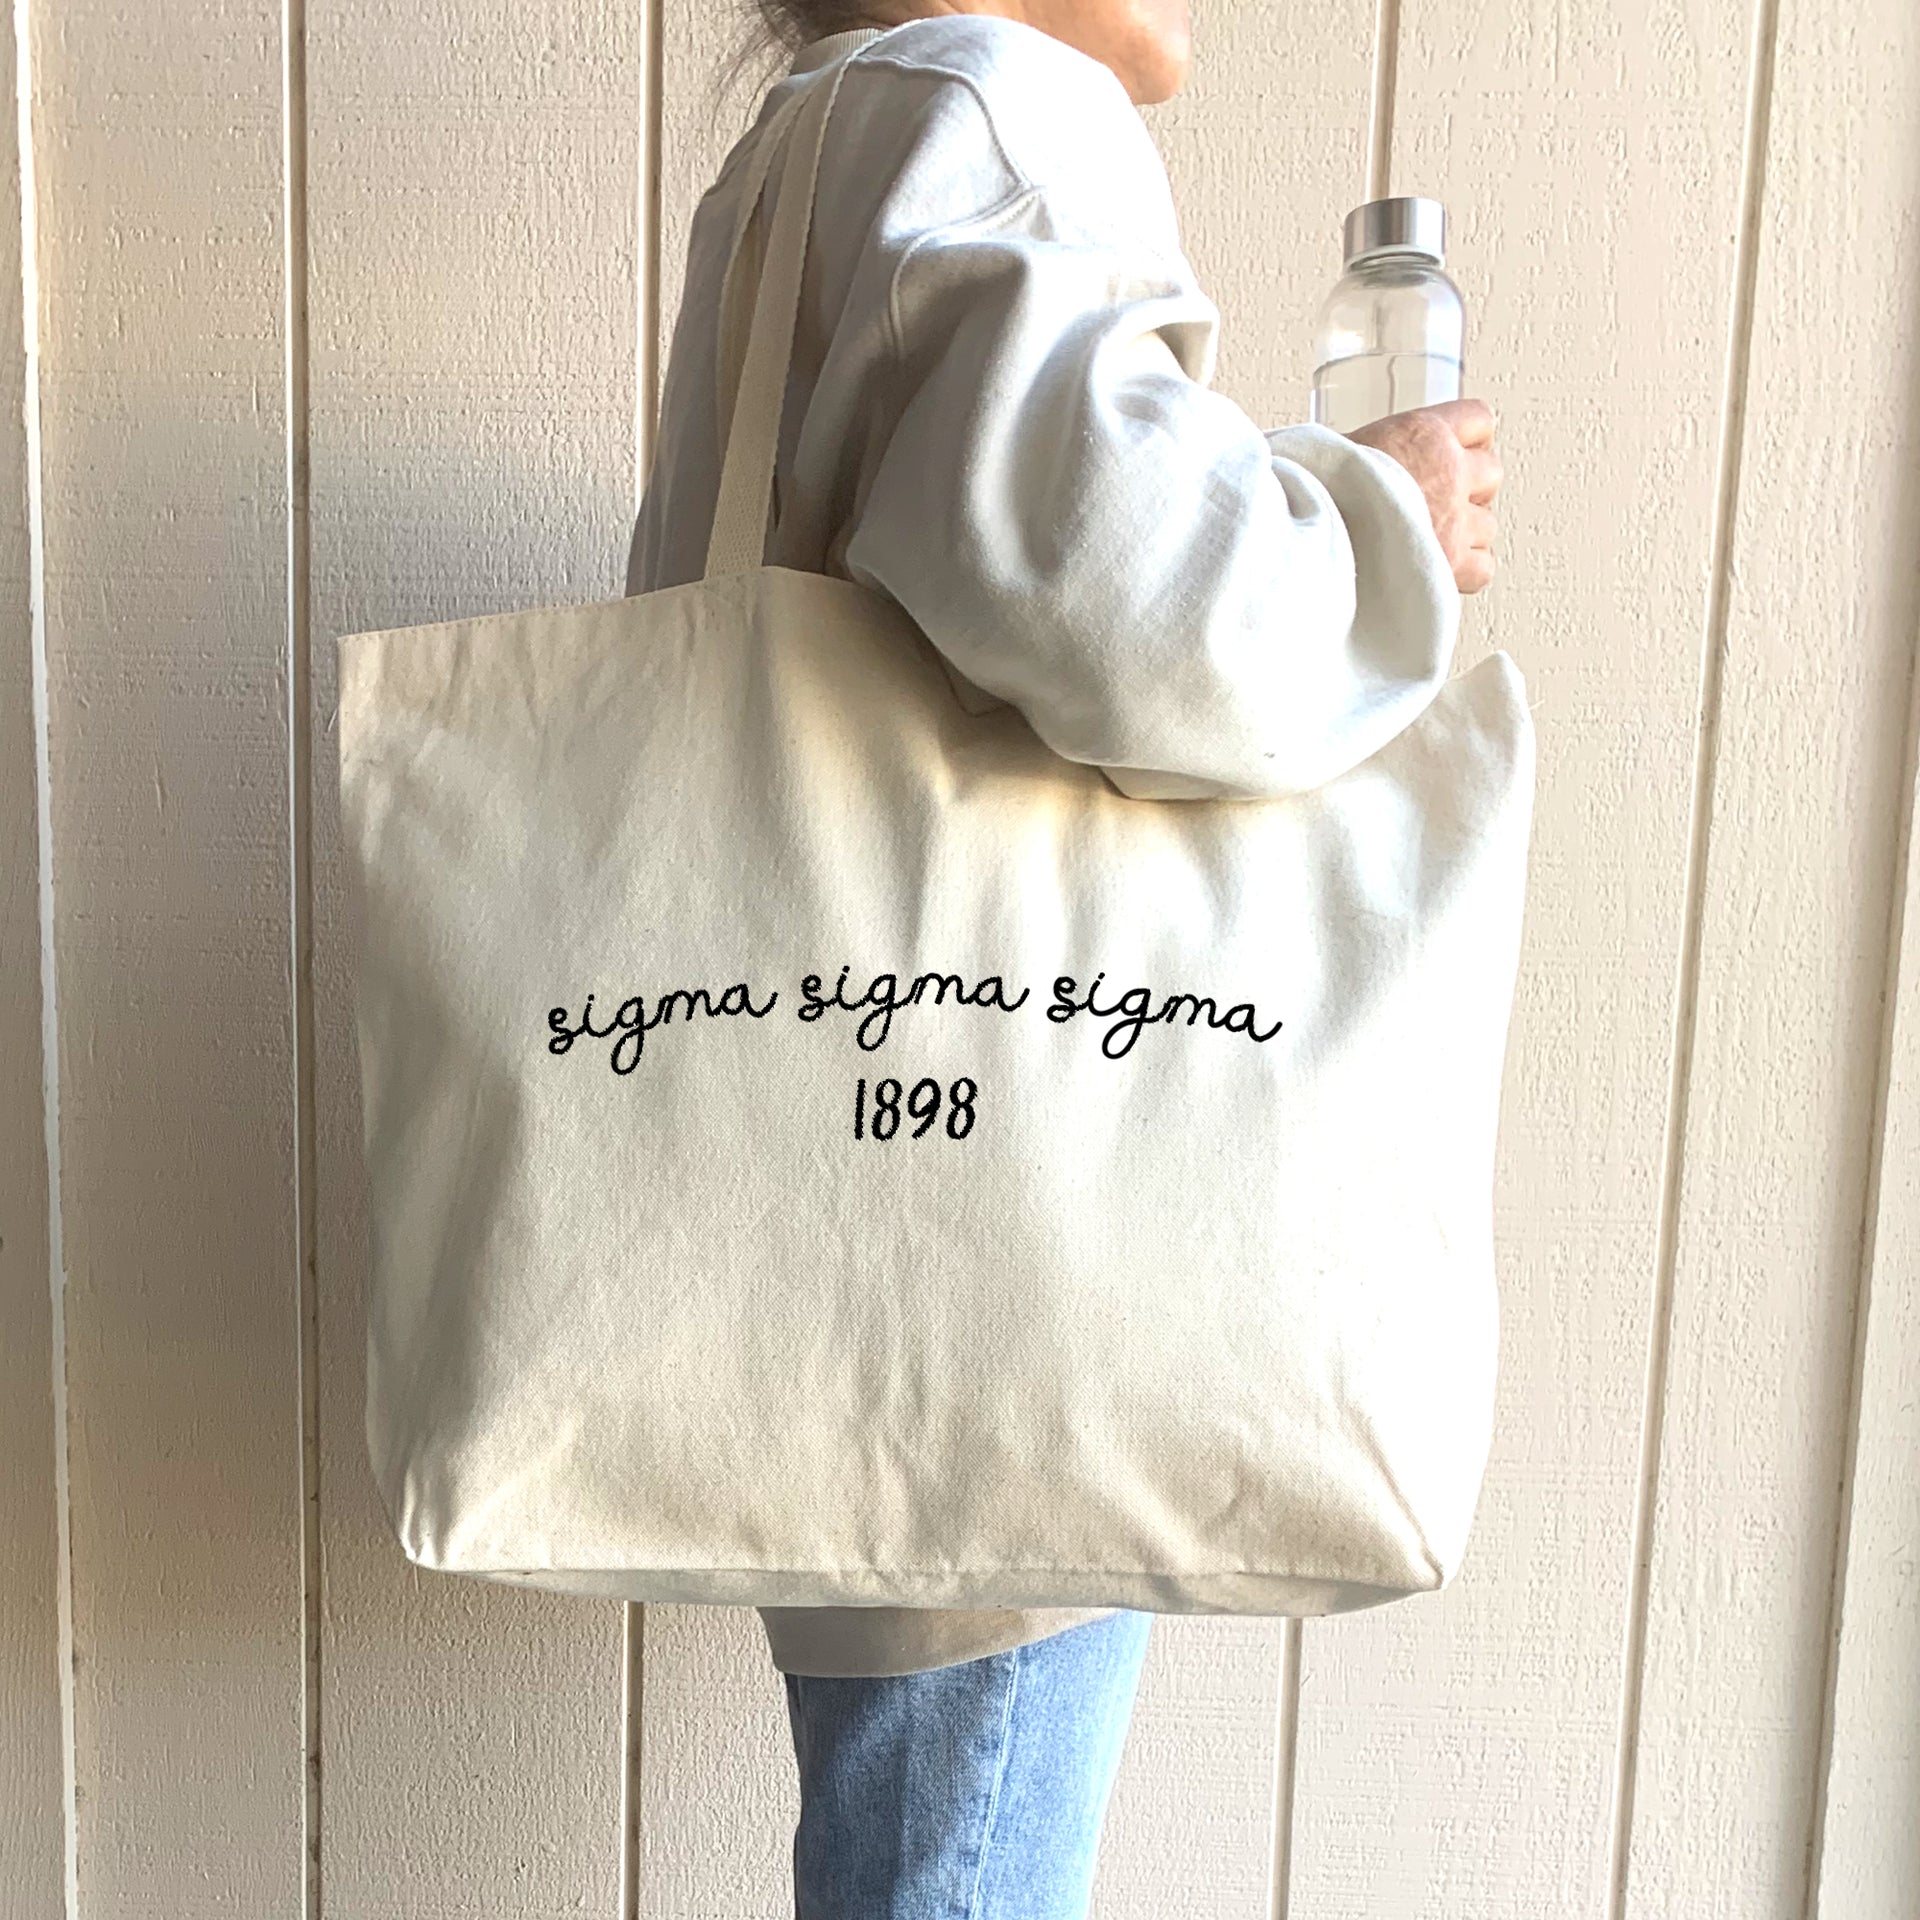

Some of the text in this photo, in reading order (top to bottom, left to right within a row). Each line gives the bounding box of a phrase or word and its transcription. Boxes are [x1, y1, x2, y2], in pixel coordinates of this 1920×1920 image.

[547, 965, 1283, 1076] sigma sigma sigma
[853, 1076, 978, 1142] 1898
